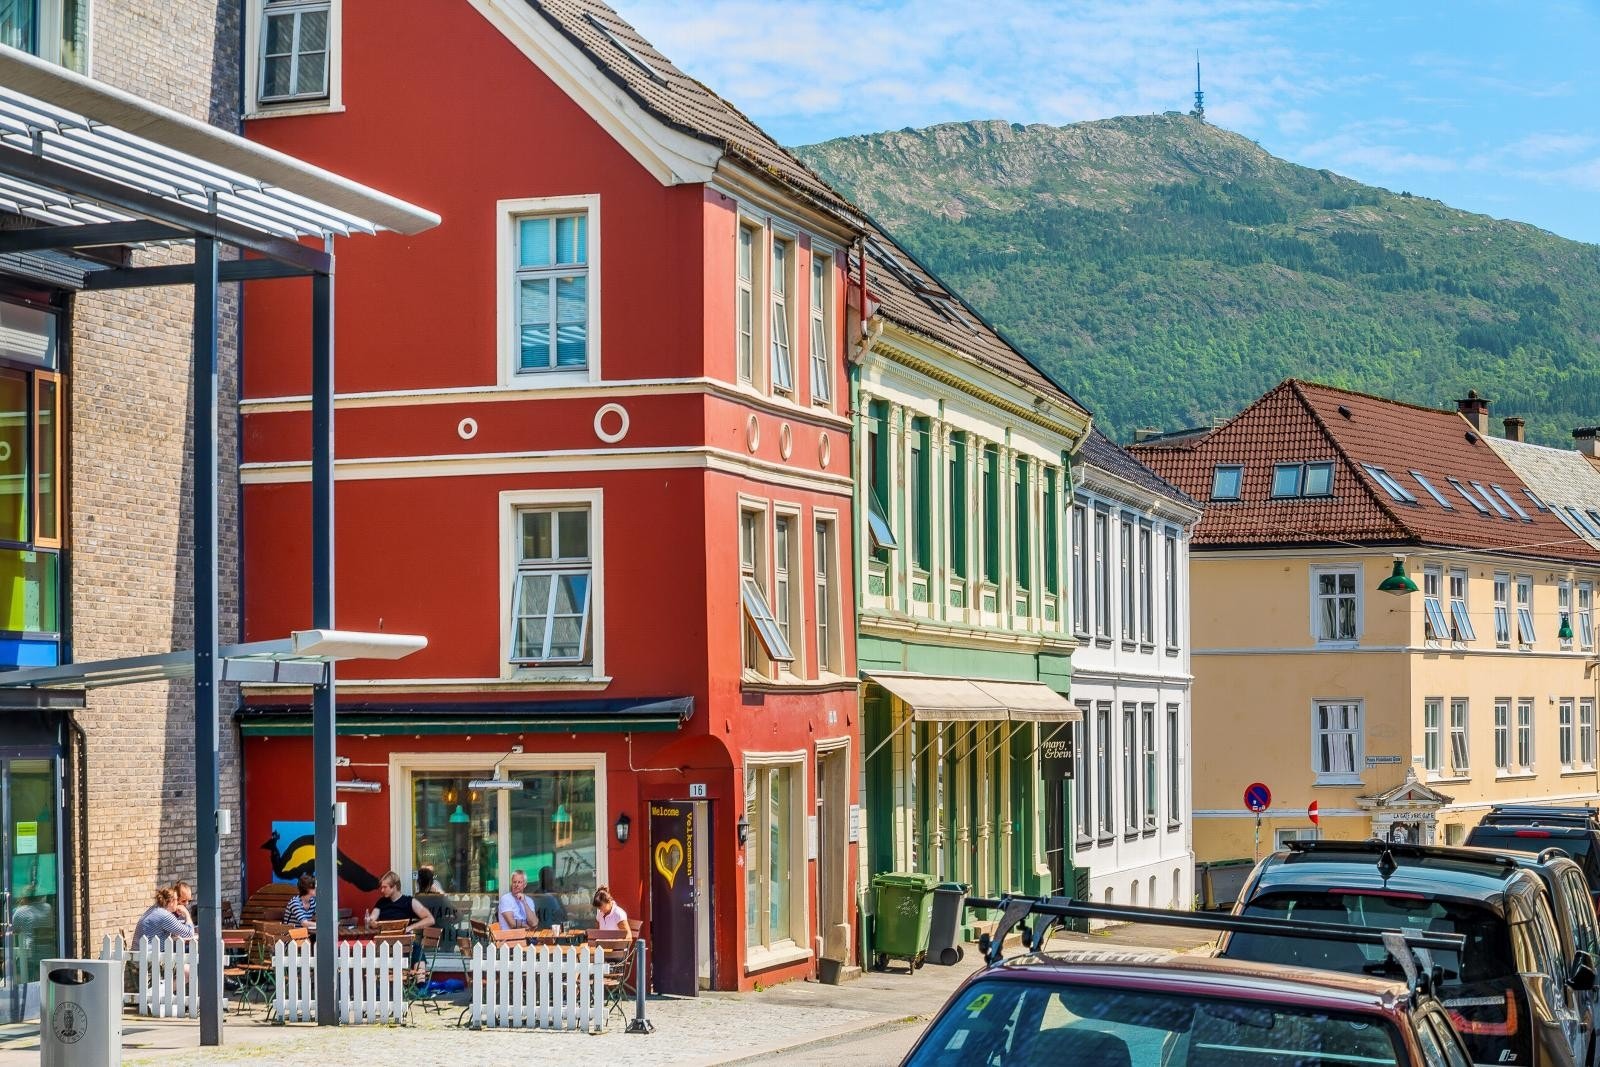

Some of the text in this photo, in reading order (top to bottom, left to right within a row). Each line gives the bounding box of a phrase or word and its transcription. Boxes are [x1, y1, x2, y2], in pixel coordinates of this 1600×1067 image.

[1043, 741, 1065, 750] marg
[693, 785, 703, 796] 16
[652, 806, 680, 817] Welcome
